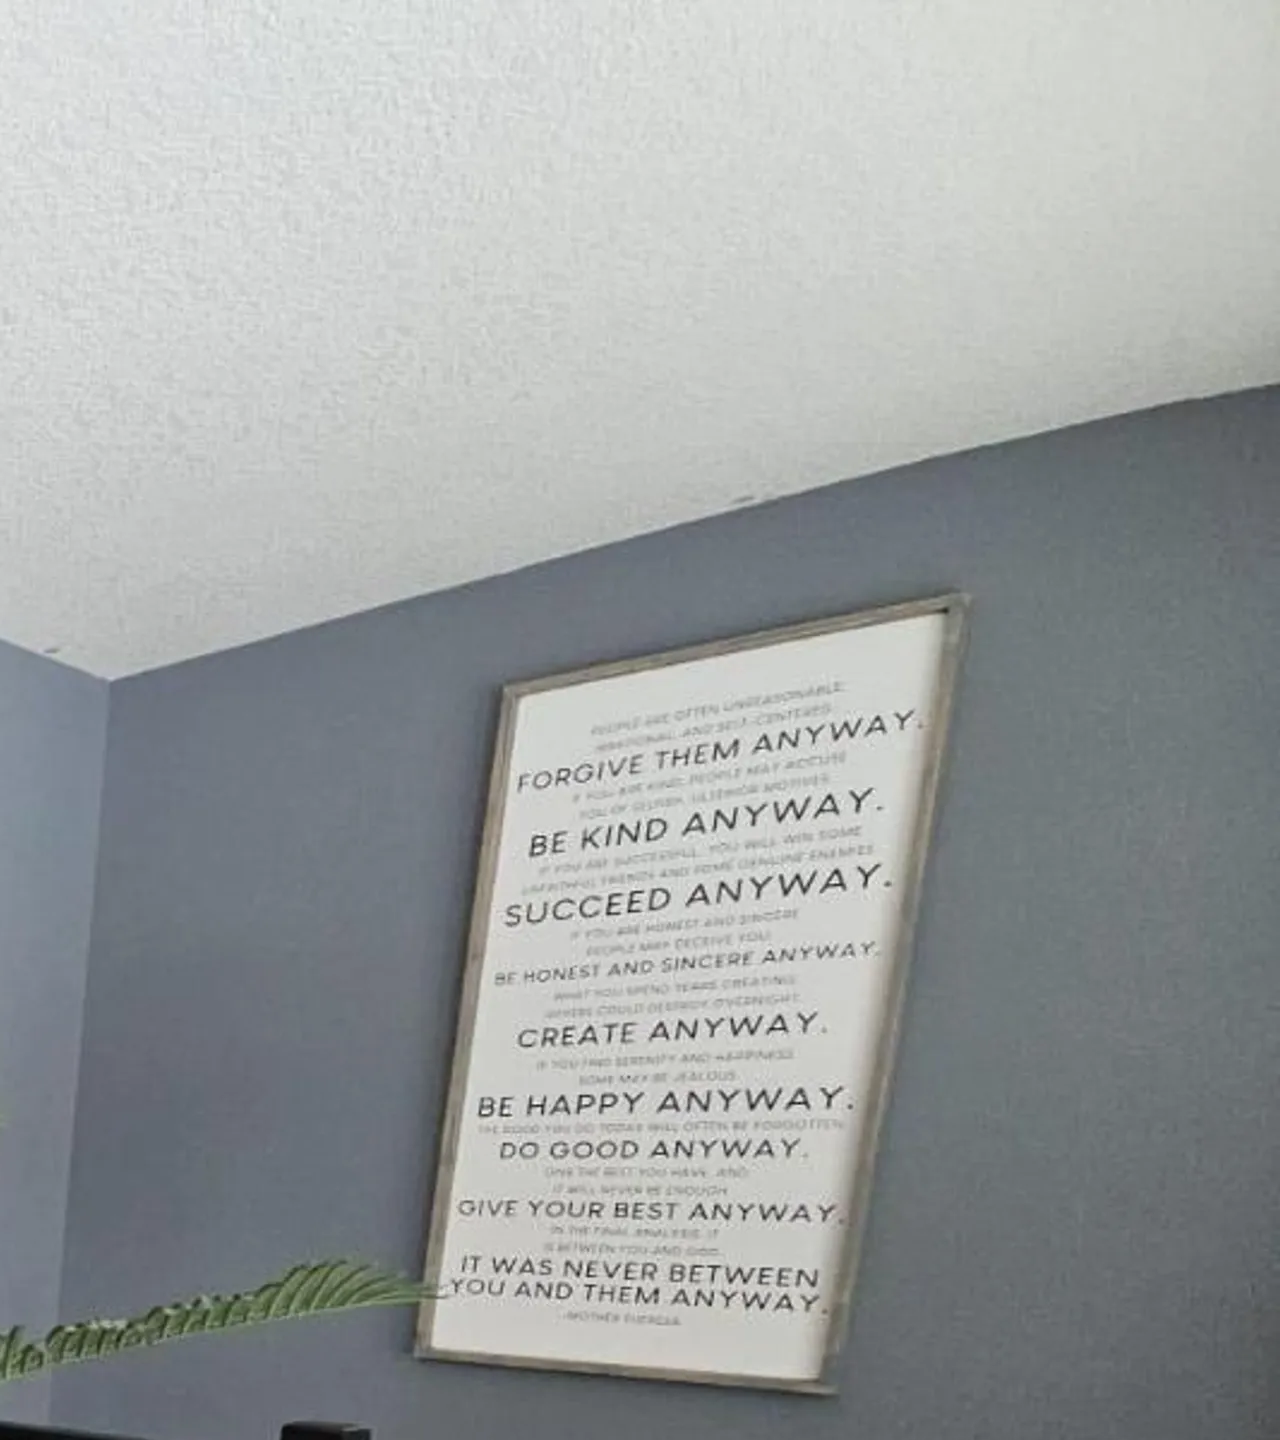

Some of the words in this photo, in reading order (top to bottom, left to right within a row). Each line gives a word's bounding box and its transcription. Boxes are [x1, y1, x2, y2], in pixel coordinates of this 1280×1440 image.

[518, 754, 642, 791] FORGIVE
[656, 739, 740, 769] THEM
[752, 710, 924, 755] ANYWAY.
[529, 831, 568, 858] BE
[581, 818, 668, 850] KIND
[681, 788, 883, 836] ANYWAY.
[505, 888, 671, 927] SUCCEED
[685, 864, 893, 908] ANYWAY.
[495, 970, 517, 986] BE
[524, 965, 598, 982] HONEST
[608, 960, 654, 975] AND
[662, 953, 749, 973] SINCERE
[762, 942, 883, 963] ANYWAY.
[518, 1022, 637, 1048] CREATE
[648, 1012, 827, 1042] ANYWAY.
[478, 1097, 514, 1118] BE
[526, 1092, 644, 1116] HAPPY
[656, 1086, 854, 1113] ANYWAY.
[500, 1142, 539, 1159] DO
[550, 1140, 639, 1160] GOOD
[649, 1138, 810, 1160] ANYWAY.
[459, 1200, 518, 1217] GIVE
[528, 1200, 605, 1218] YOUR
[613, 1202, 678, 1220] BEST
[688, 1203, 846, 1224] ANYWAY.
[462, 1256, 481, 1272] IT
[492, 1257, 552, 1275] WAS
[563, 1260, 658, 1281] NEVER
[669, 1263, 818, 1288] BETWEEN
[451, 1279, 505, 1296] YOU
[514, 1281, 573, 1300] AND
[584, 1284, 660, 1304] THEM
[671, 1289, 829, 1314] ANYWAY.
